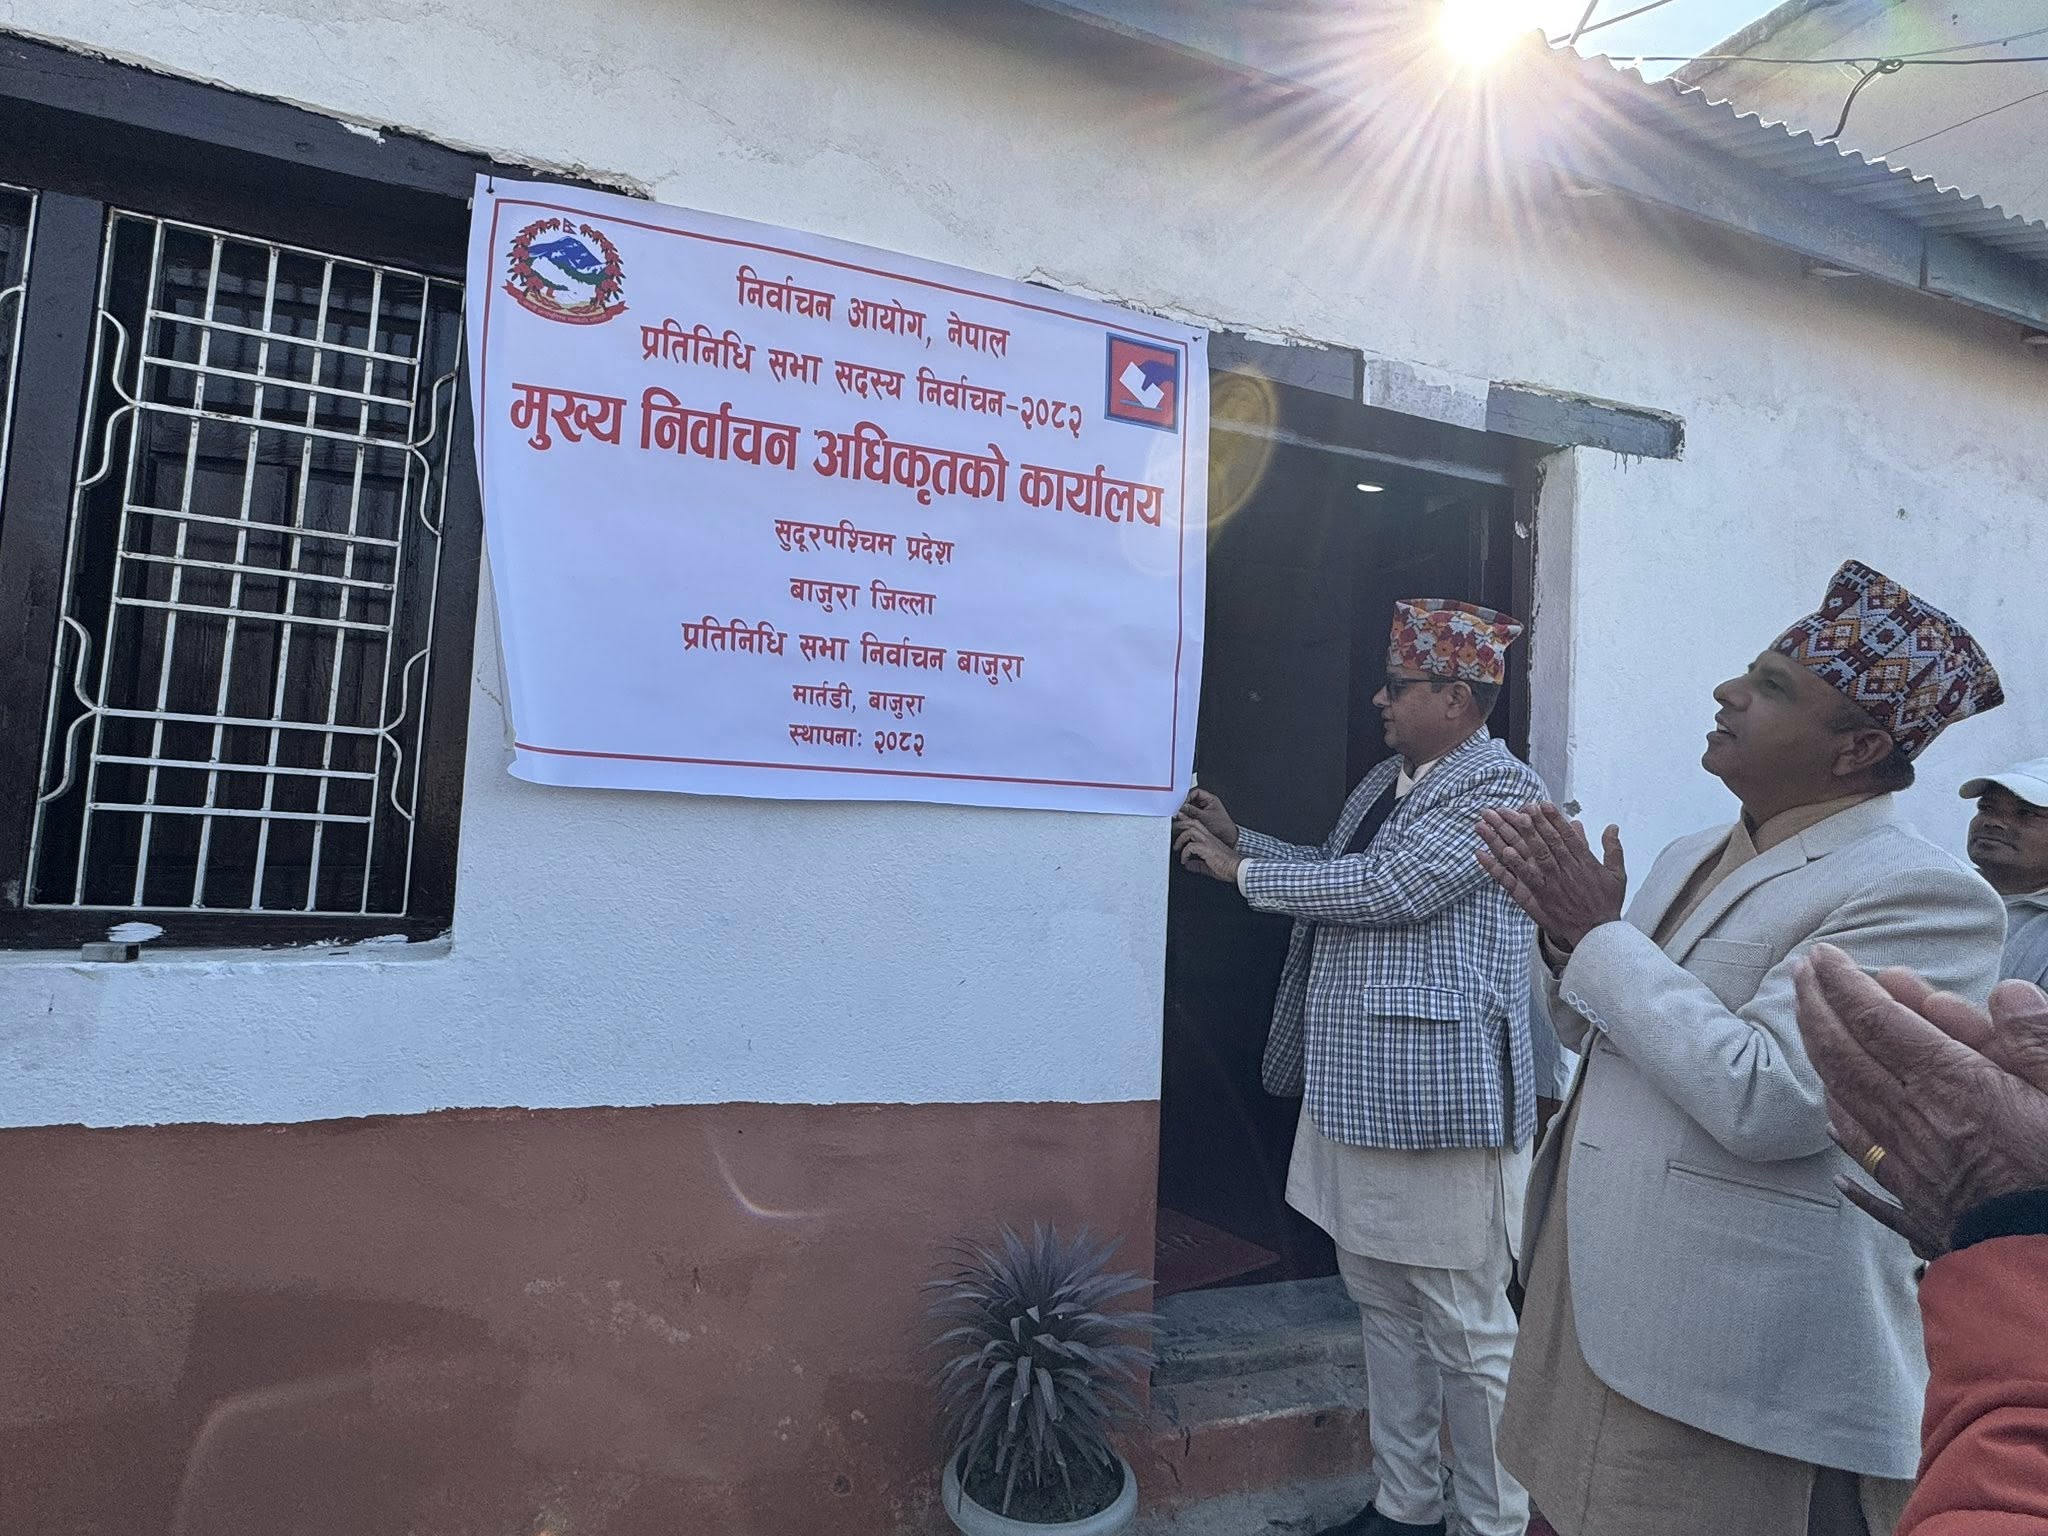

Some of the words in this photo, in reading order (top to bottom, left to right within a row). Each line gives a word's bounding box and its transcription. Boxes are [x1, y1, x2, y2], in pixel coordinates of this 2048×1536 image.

[735, 264, 836, 322] निर्वाचन
[847, 297, 932, 349] आयोग,
[946, 310, 1011, 359] नेपाल
[639, 318, 757, 374] प्रतिनिधि
[767, 348, 824, 386] सभा
[834, 360, 906, 401] सदस्य
[915, 366, 1082, 439] निर्वाचन-२०८२
[510, 382, 628, 451] मुख्य
[640, 386, 802, 471] निर्वाचन
[812, 420, 1010, 506] अधिकृतको
[1019, 463, 1163, 527] कार्यालय
[774, 519, 897, 556] सुदूरपश्चिम
[905, 532, 955, 566] प्रदेश
[789, 577, 861, 614] बाजुरा
[869, 579, 937, 617] जिल्ला
[681, 615, 789, 657] प्रतिनिधि
[798, 634, 851, 663] सभा
[859, 631, 948, 672] निर्वाचन
[956, 650, 1025, 686] बाजुरा
[868, 691, 926, 720] बाजुरा
[874, 730, 925, 758] २०८२
